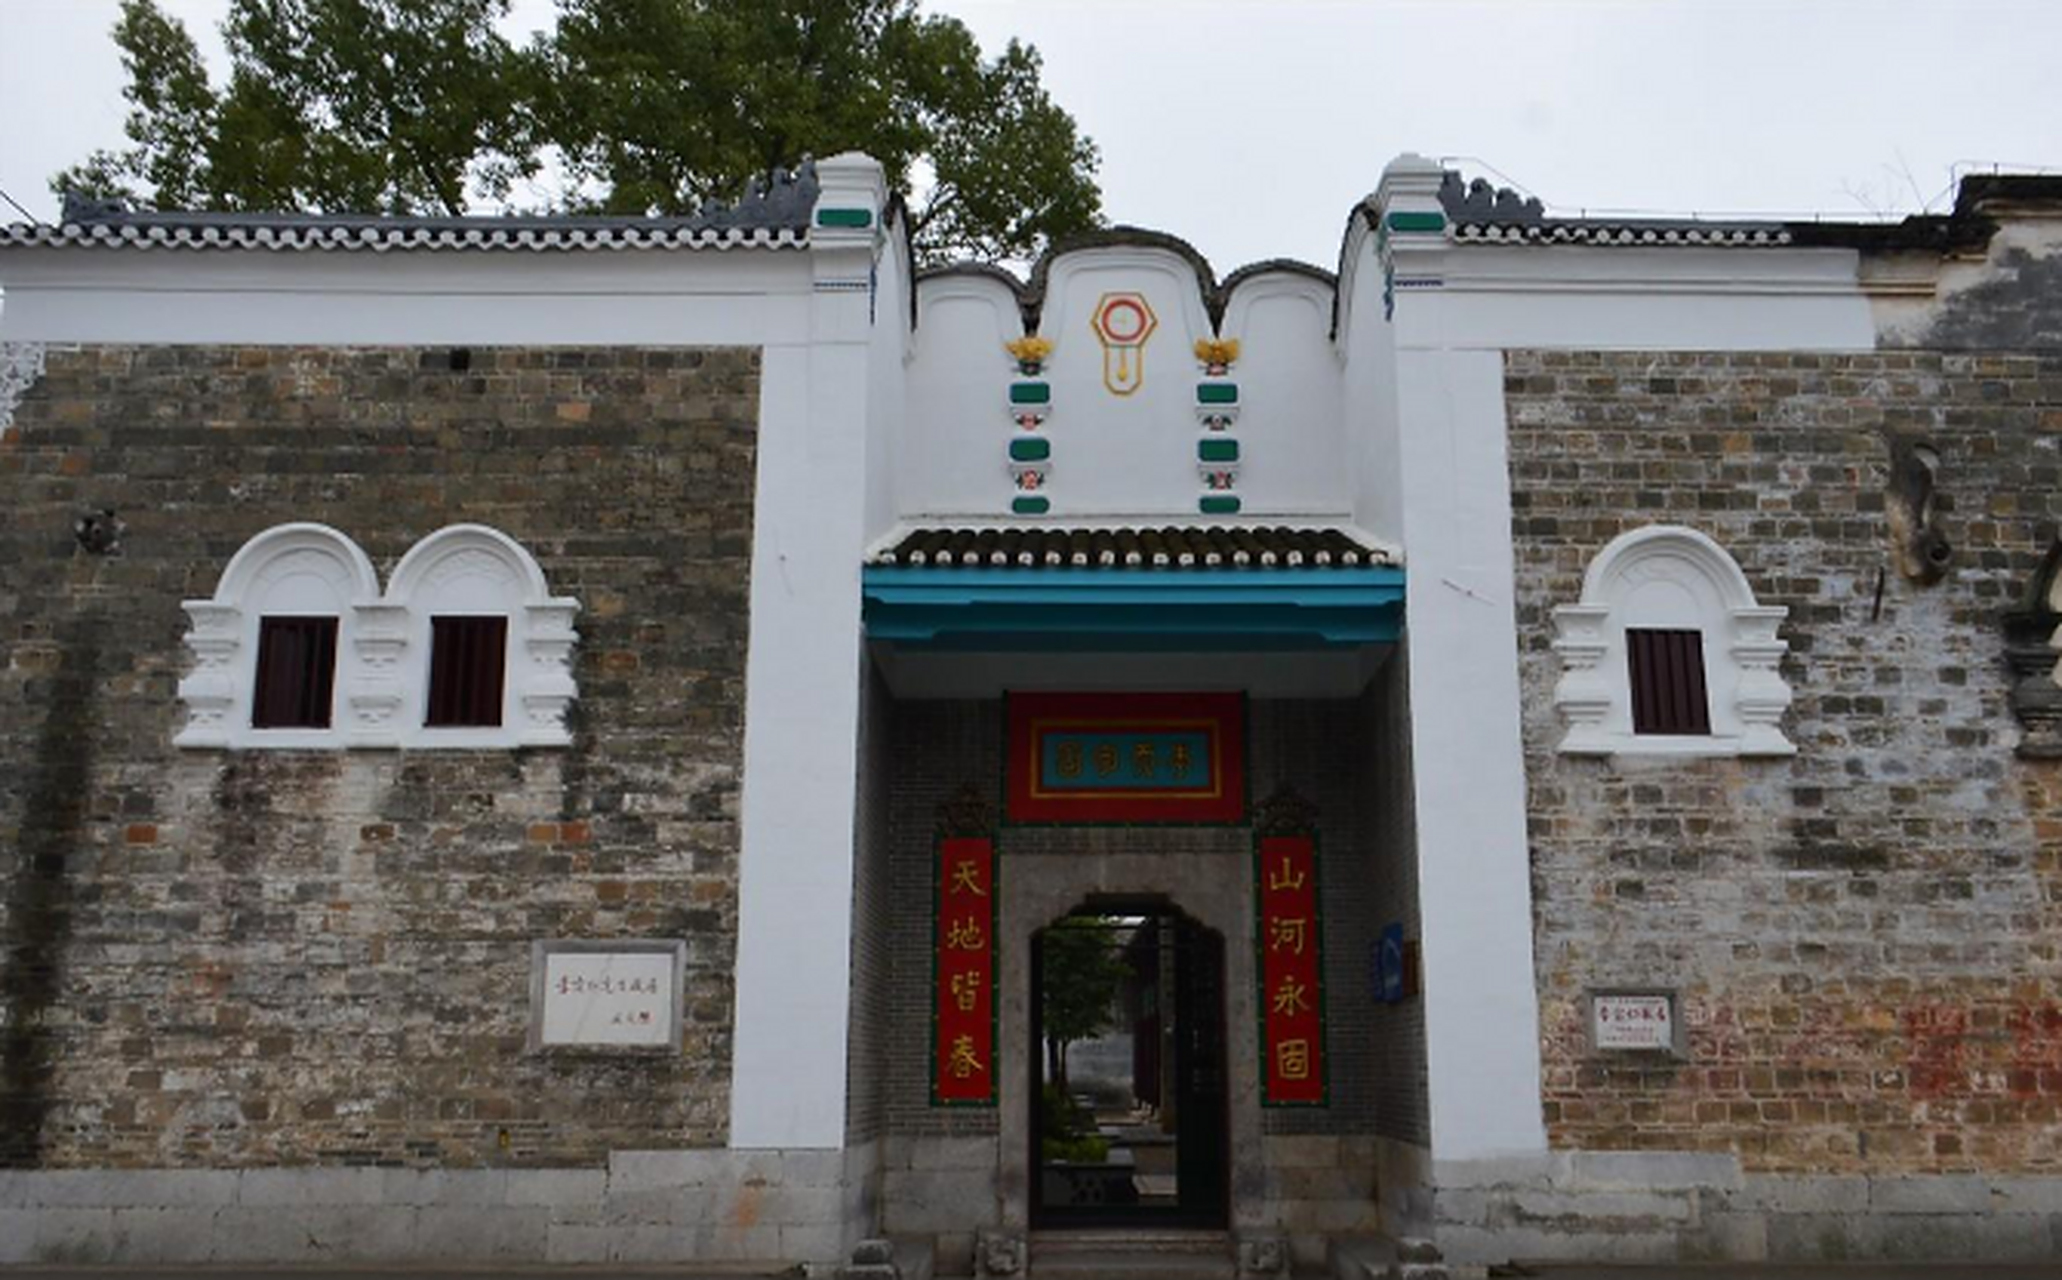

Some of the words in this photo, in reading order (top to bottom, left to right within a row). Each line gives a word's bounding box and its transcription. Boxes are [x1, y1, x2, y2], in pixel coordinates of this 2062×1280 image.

[946, 859, 986, 1078] 天地皆春
[1270, 856, 1310, 1080] 山河永固
